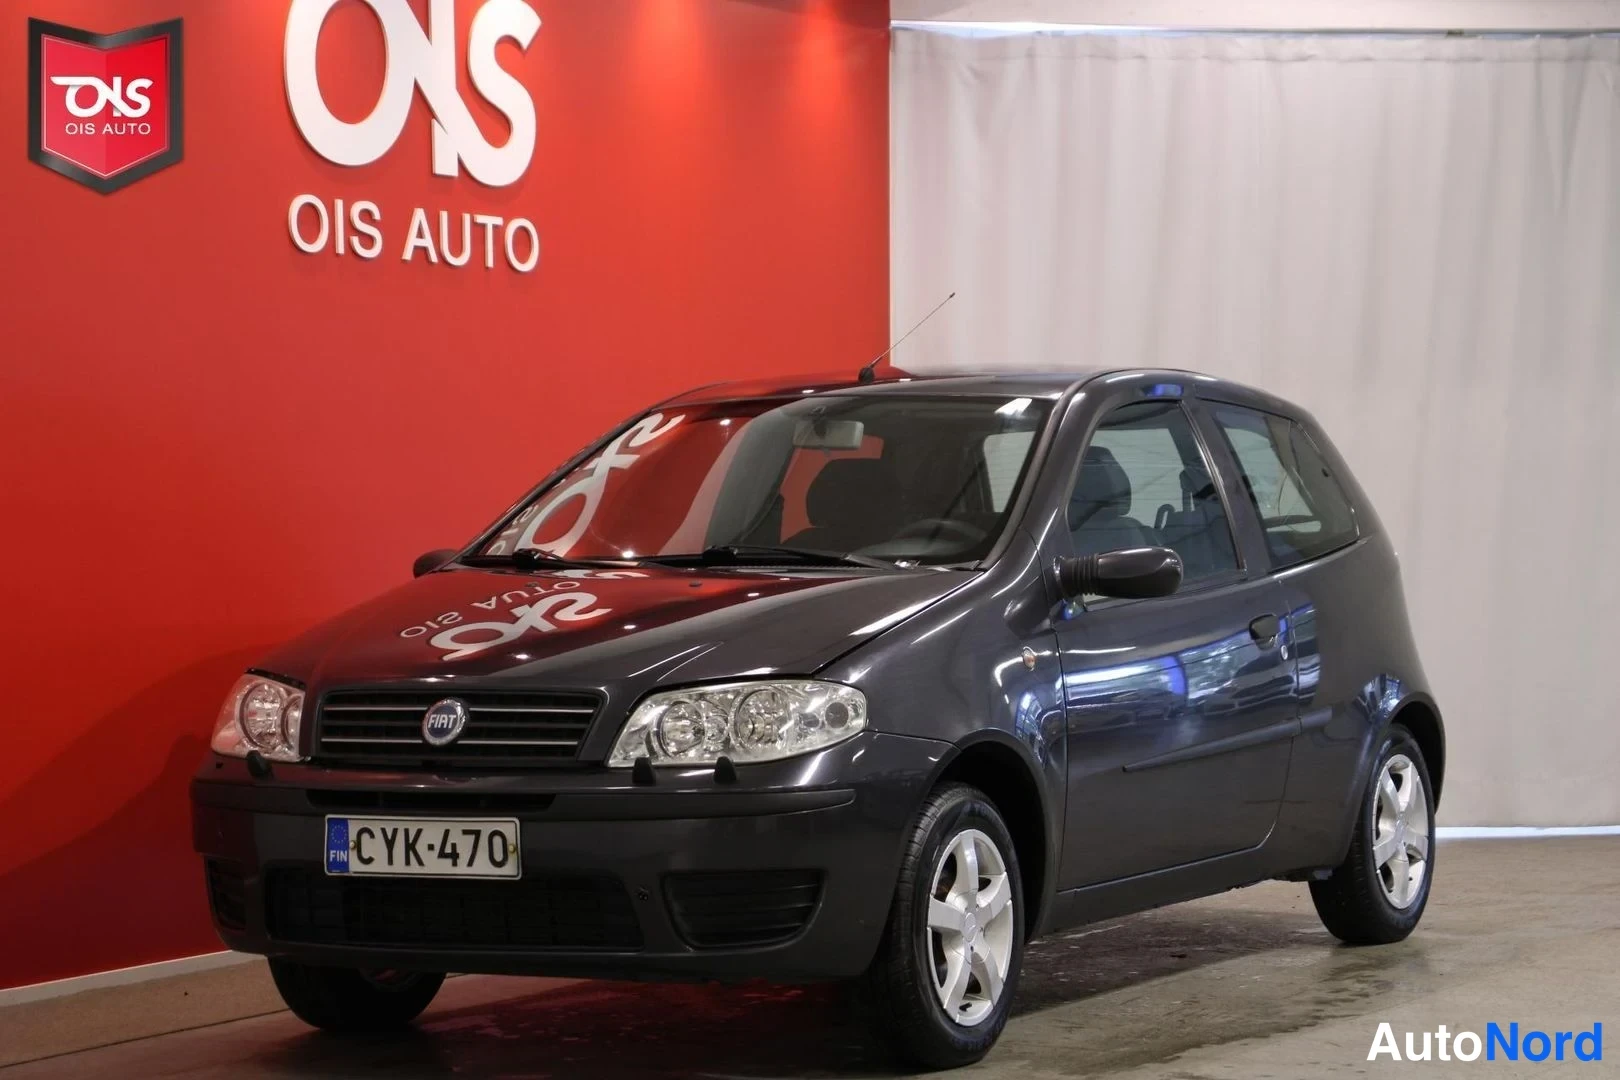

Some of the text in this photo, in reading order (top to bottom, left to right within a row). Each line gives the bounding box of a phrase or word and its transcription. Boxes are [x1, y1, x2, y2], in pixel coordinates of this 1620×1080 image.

[288, 193, 541, 273] OIS AUTO
[427, 713, 457, 729] FIAT
[329, 850, 348, 862] FIN
[355, 826, 509, 868] CYK-470
